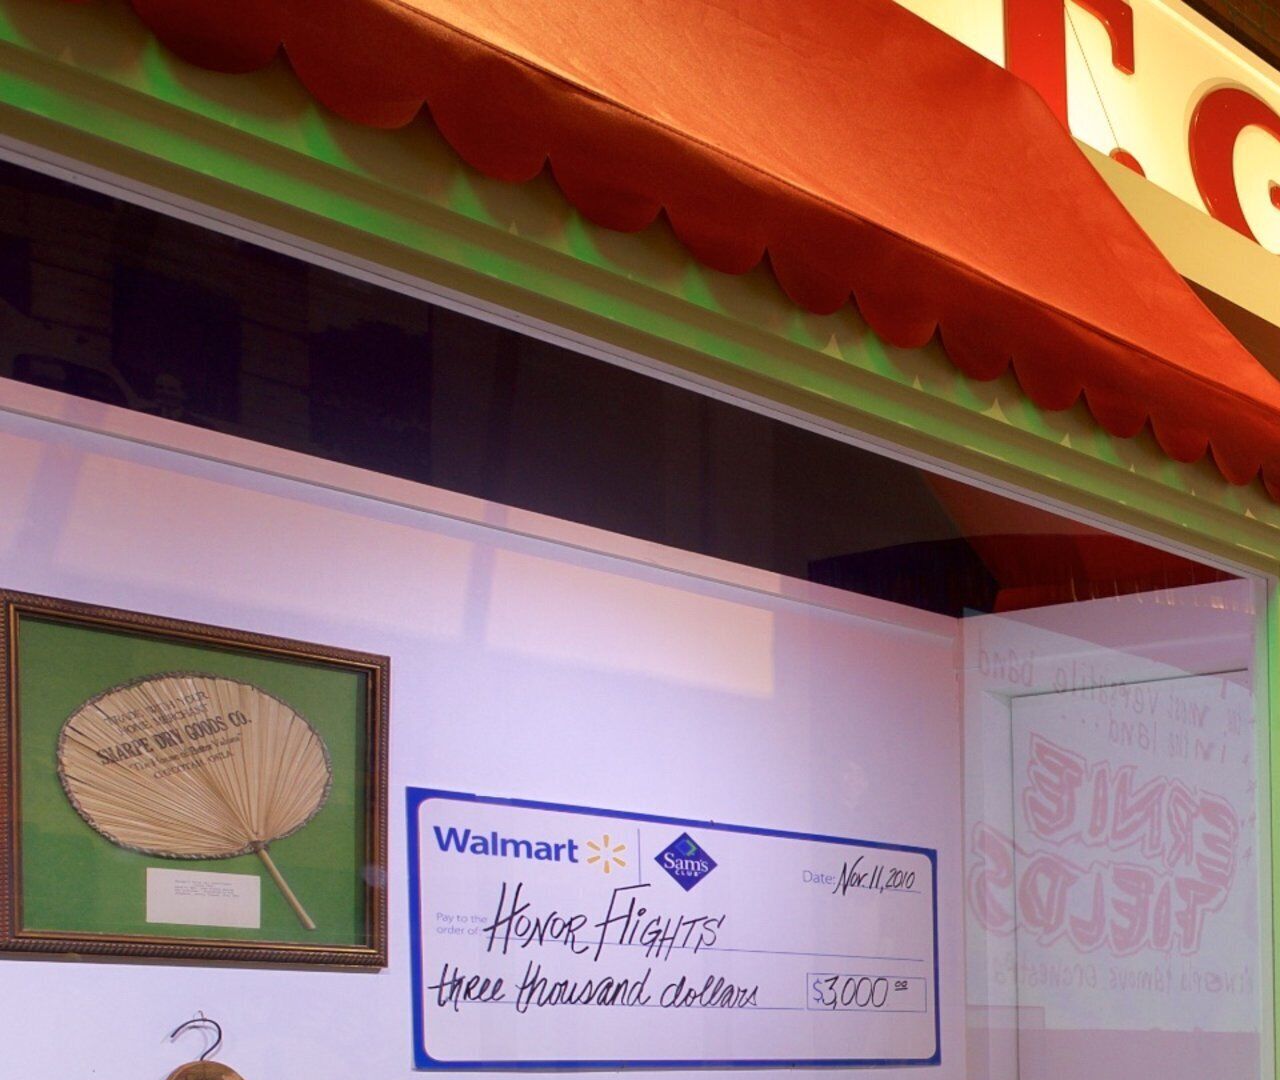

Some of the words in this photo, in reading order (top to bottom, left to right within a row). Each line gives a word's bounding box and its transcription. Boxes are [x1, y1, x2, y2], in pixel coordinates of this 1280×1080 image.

[157, 730, 185, 749] DRY
[185, 716, 227, 740] GOODS
[229, 710, 252, 727] CO.
[433, 825, 579, 863] Walmart
[664, 852, 709, 873] Sam's
[802, 870, 835, 884] Date:
[885, 867, 916, 890] 2010
[436, 913, 454, 924] Pay
[457, 914, 468, 923] to
[472, 914, 488, 923] the
[436, 925, 465, 936] order
[516, 961, 651, 1014] thousand
[660, 975, 758, 1008] dollars
